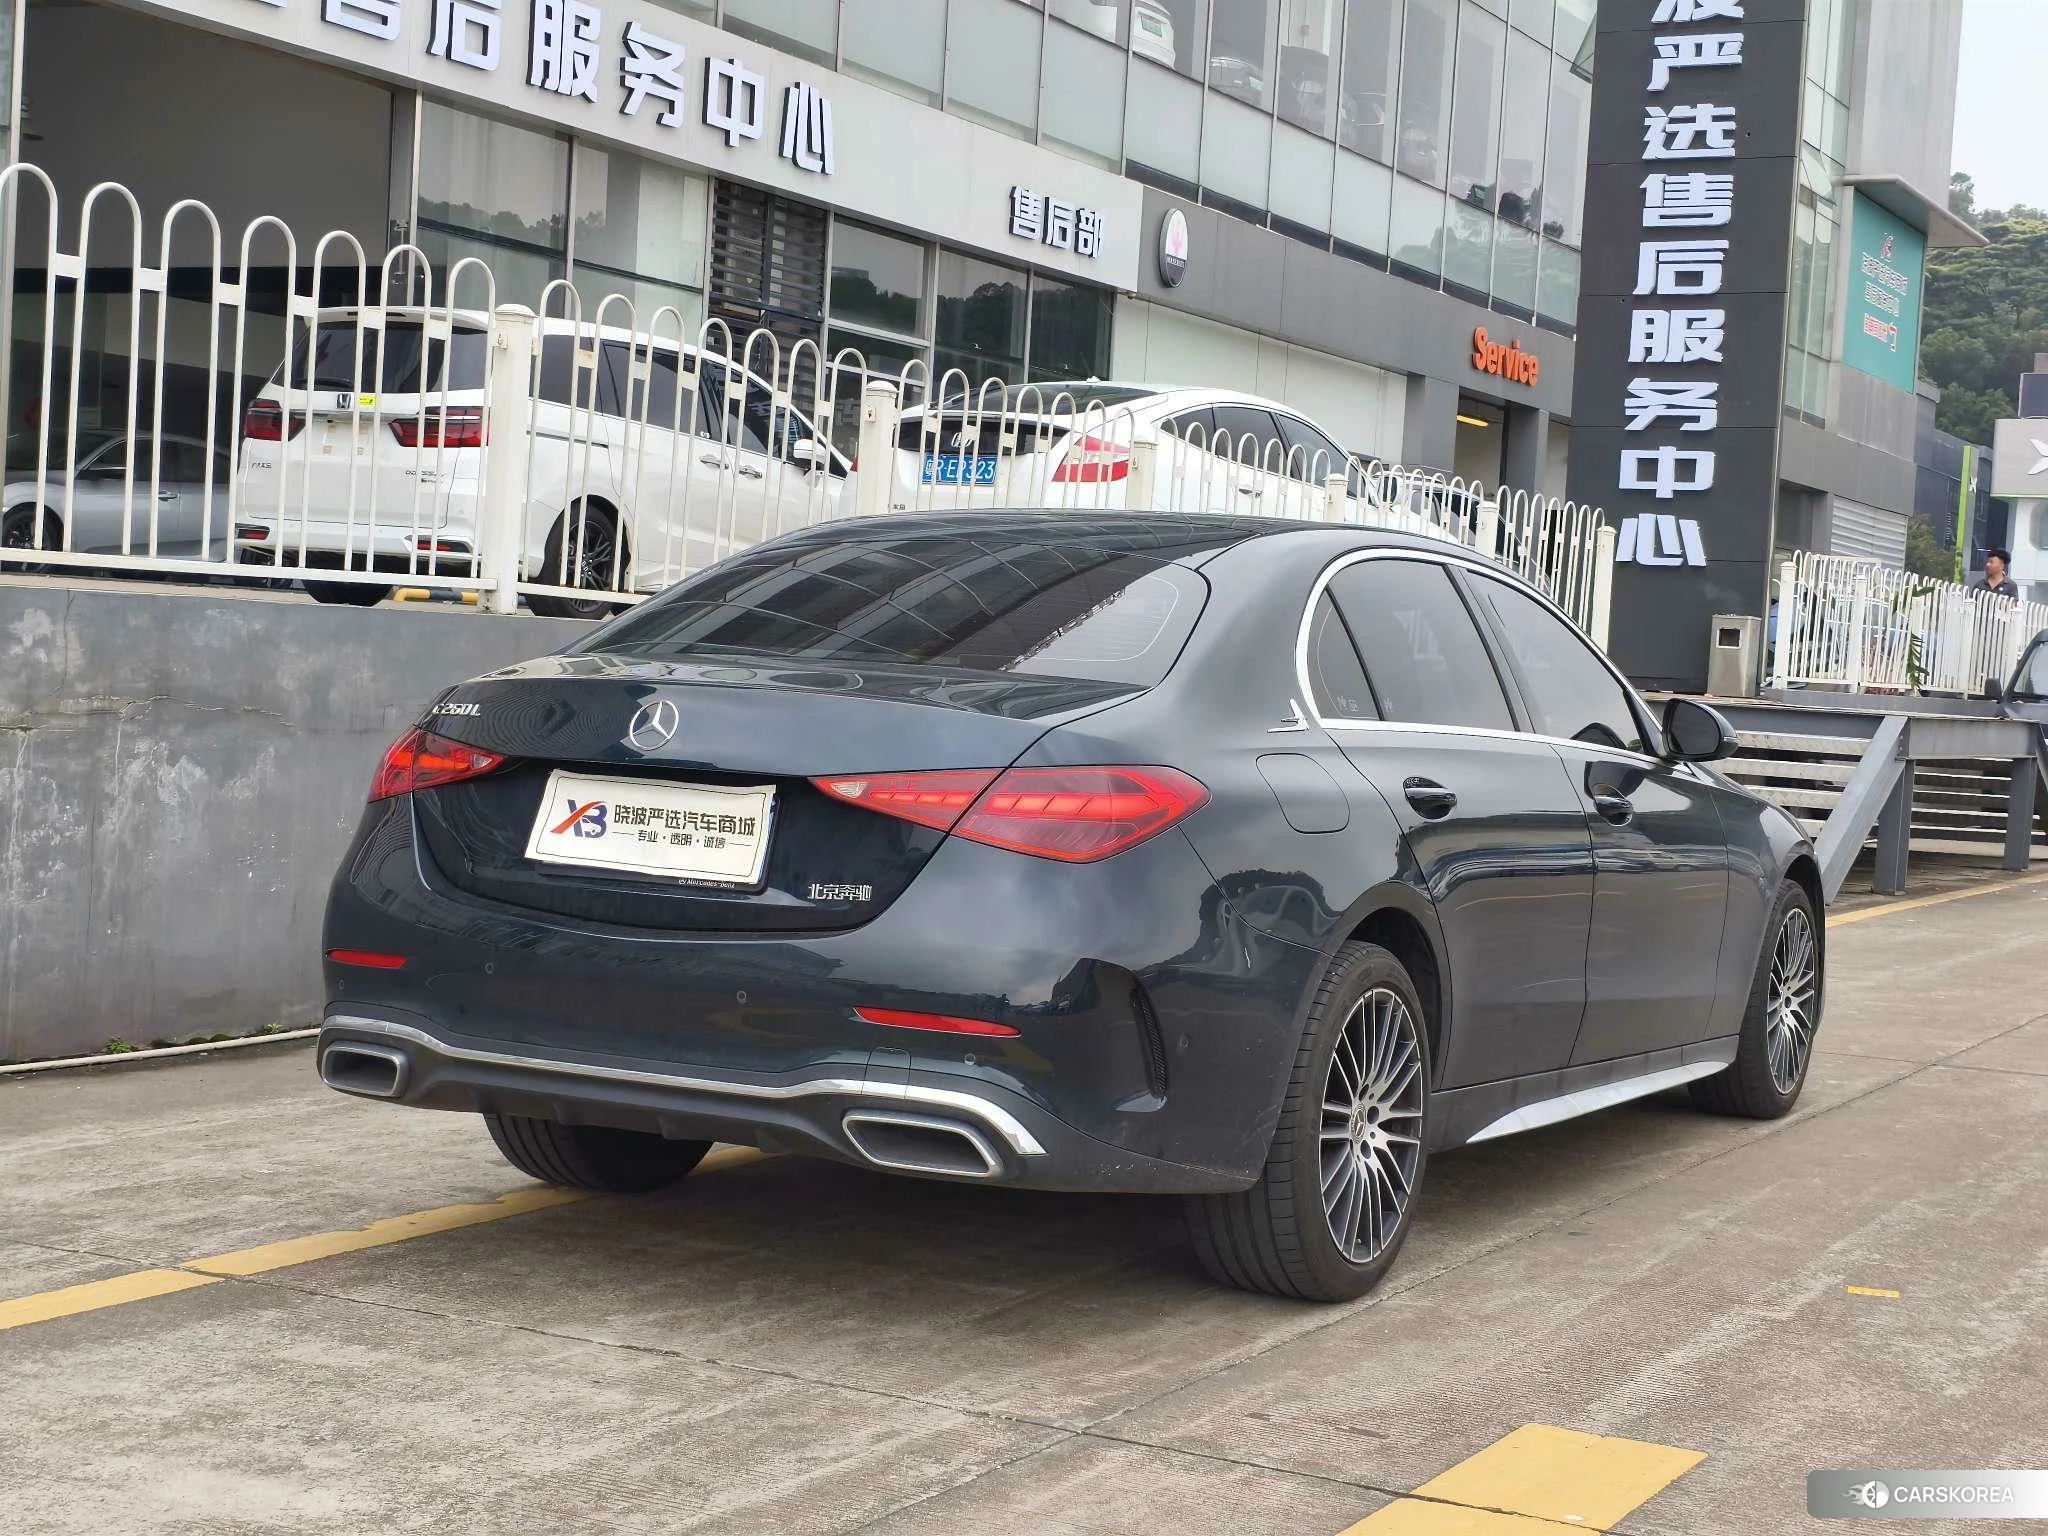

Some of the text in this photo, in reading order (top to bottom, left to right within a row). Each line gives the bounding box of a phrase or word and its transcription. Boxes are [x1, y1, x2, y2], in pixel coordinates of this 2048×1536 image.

[1009, 184, 1105, 258] 售后部
[1471, 325, 1539, 386] Service
[613, 804, 756, 837] 晓波严选汽车商城
[807, 884, 872, 901] 北京奔驰
